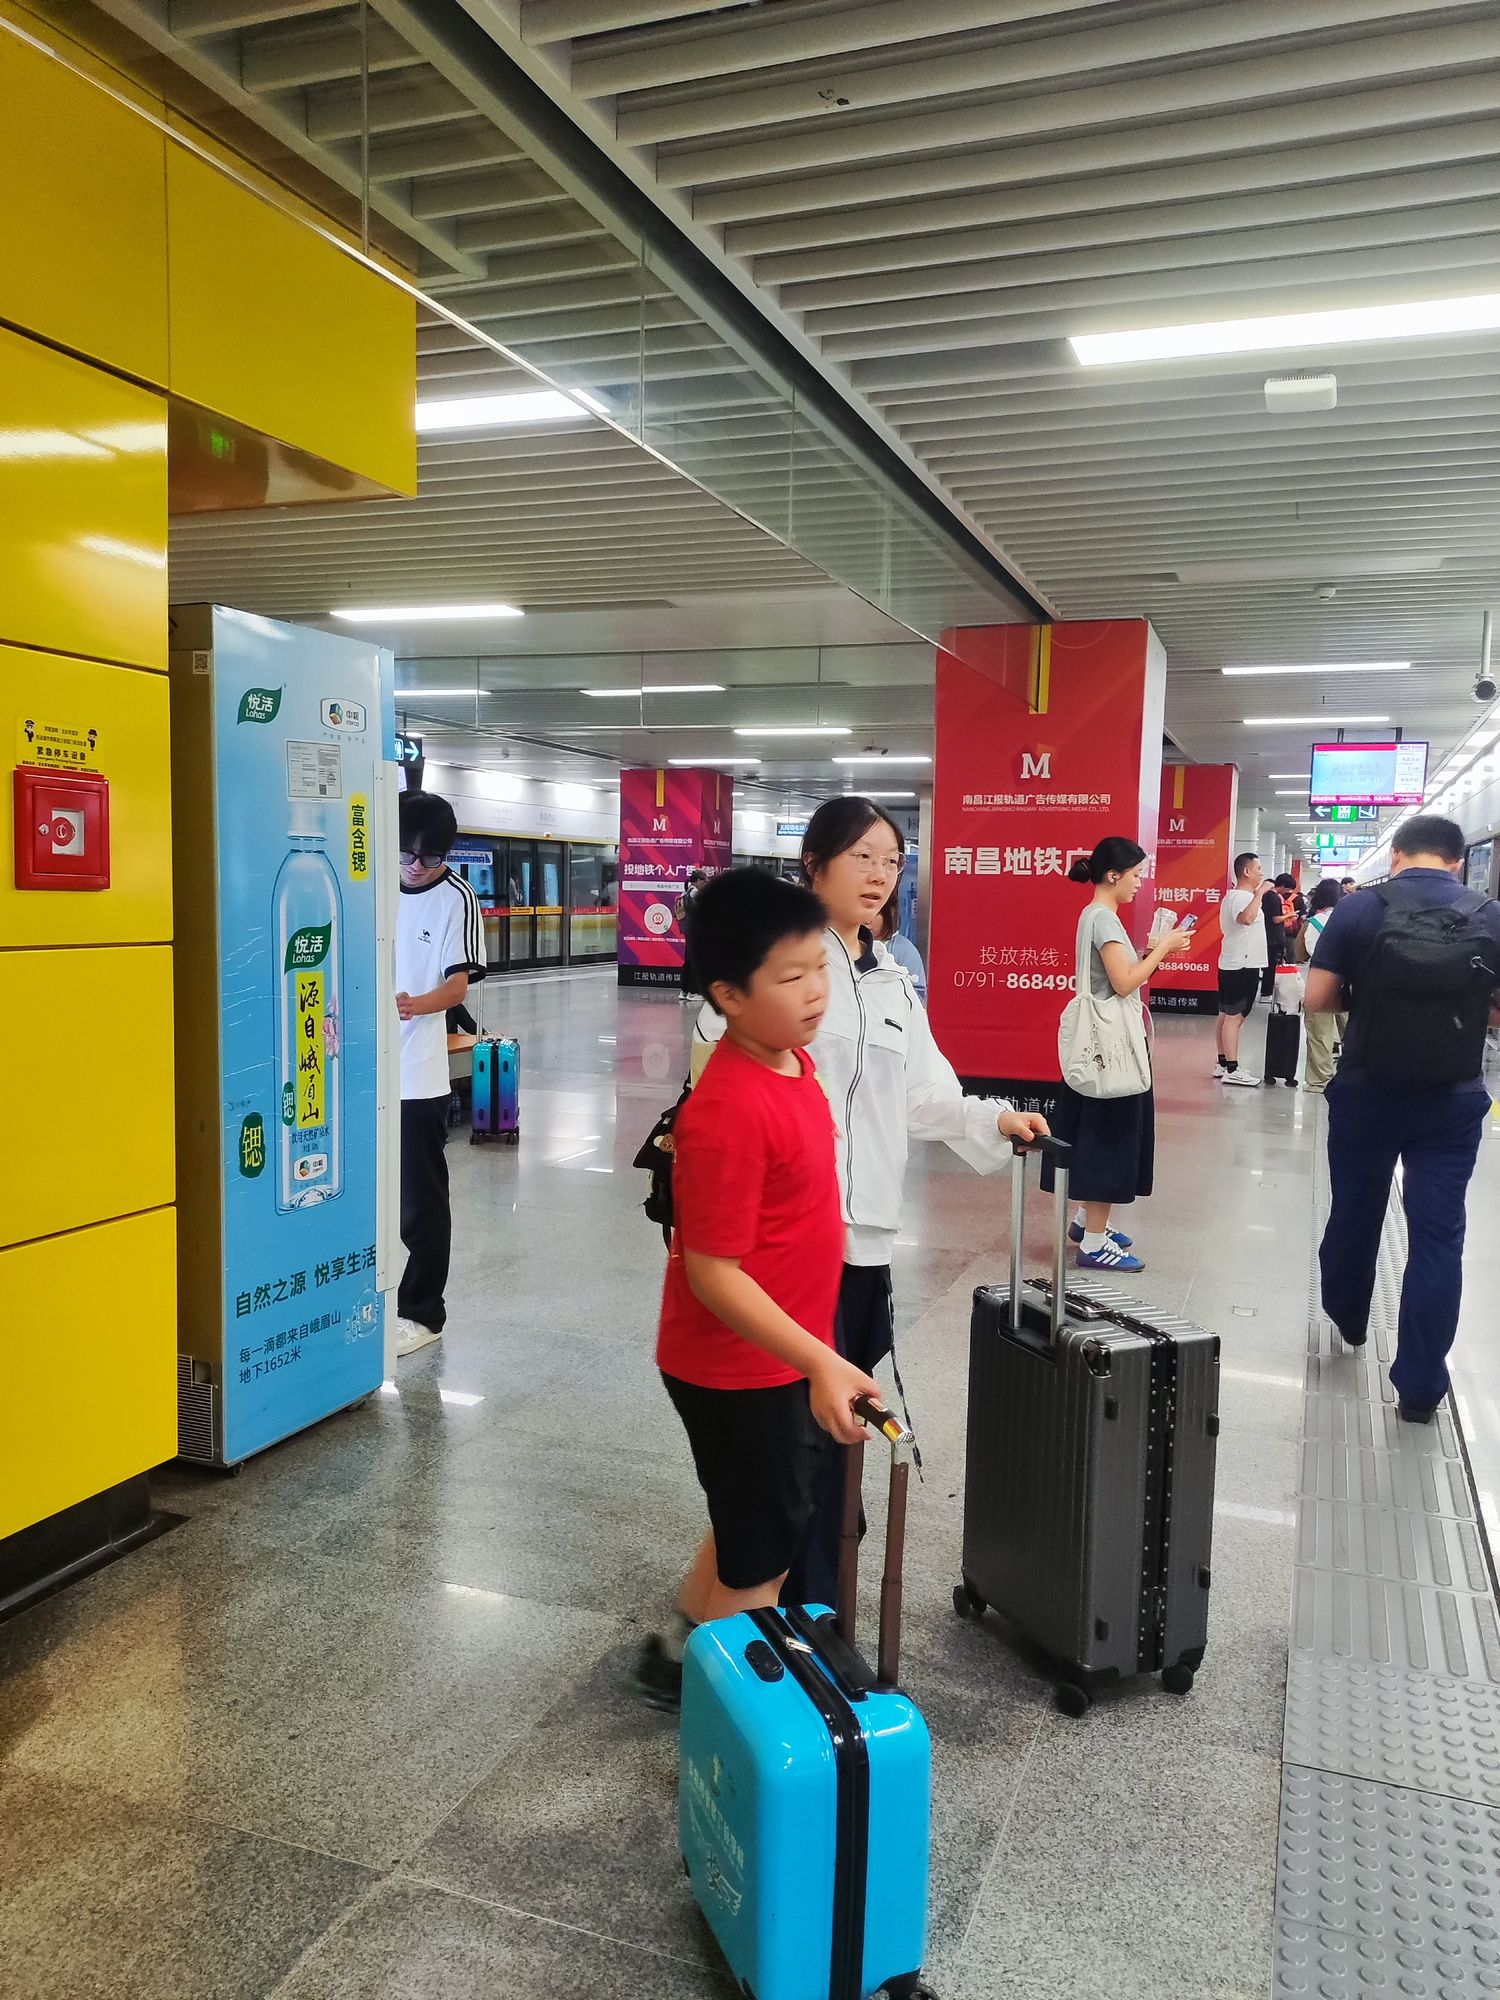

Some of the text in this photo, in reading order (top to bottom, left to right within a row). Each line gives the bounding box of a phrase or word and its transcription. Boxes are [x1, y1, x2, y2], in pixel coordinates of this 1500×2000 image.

[248, 693, 273, 712] 悦活
[245, 708, 266, 719] Lohas
[1020, 753, 1051, 779] M
[962, 794, 1111, 805] 南昌江报轨道广告传媒有限公司
[653, 818, 667, 831] M
[1169, 819, 1185, 832] M
[352, 804, 366, 872] 富含锶
[624, 864, 696, 877] 投地铁个人广告
[295, 935, 323, 953] 悦活
[292, 953, 315, 963] Lohas
[1158, 962, 1210, 972] 86849068
[299, 981, 321, 1122] 源自峨眉山
[967, 1094, 1057, 1115] 轨道传
[242, 1125, 262, 1168] 锶
[236, 1244, 376, 1318] 自然之源 悦享生活
[239, 1310, 341, 1364] 每一滴都来自峨眉山
[239, 1345, 301, 1384] 地下1652米
